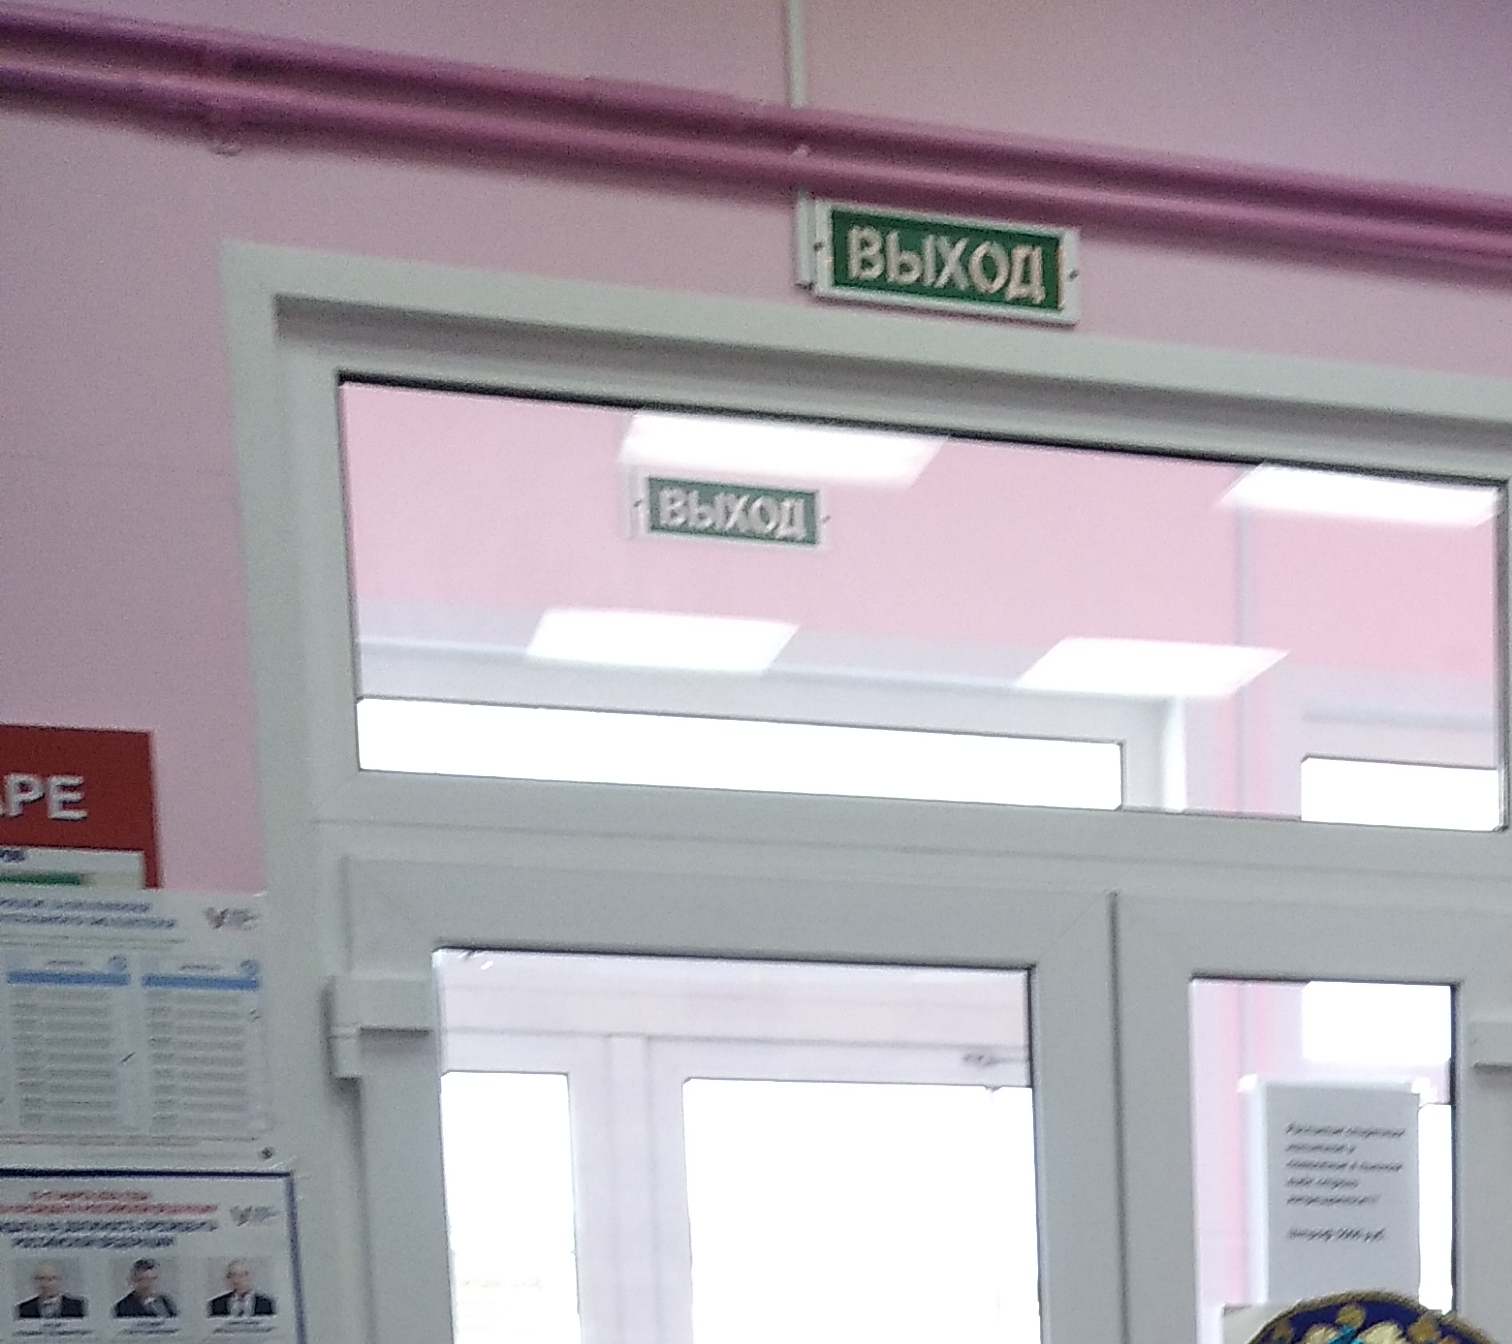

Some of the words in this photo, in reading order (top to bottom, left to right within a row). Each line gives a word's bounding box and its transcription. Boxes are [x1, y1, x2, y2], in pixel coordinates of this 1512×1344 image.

[849, 225, 1045, 304] ВЫХОД
[659, 487, 806, 540] ВЫХОД
[0, 774, 88, 820] РЕ
